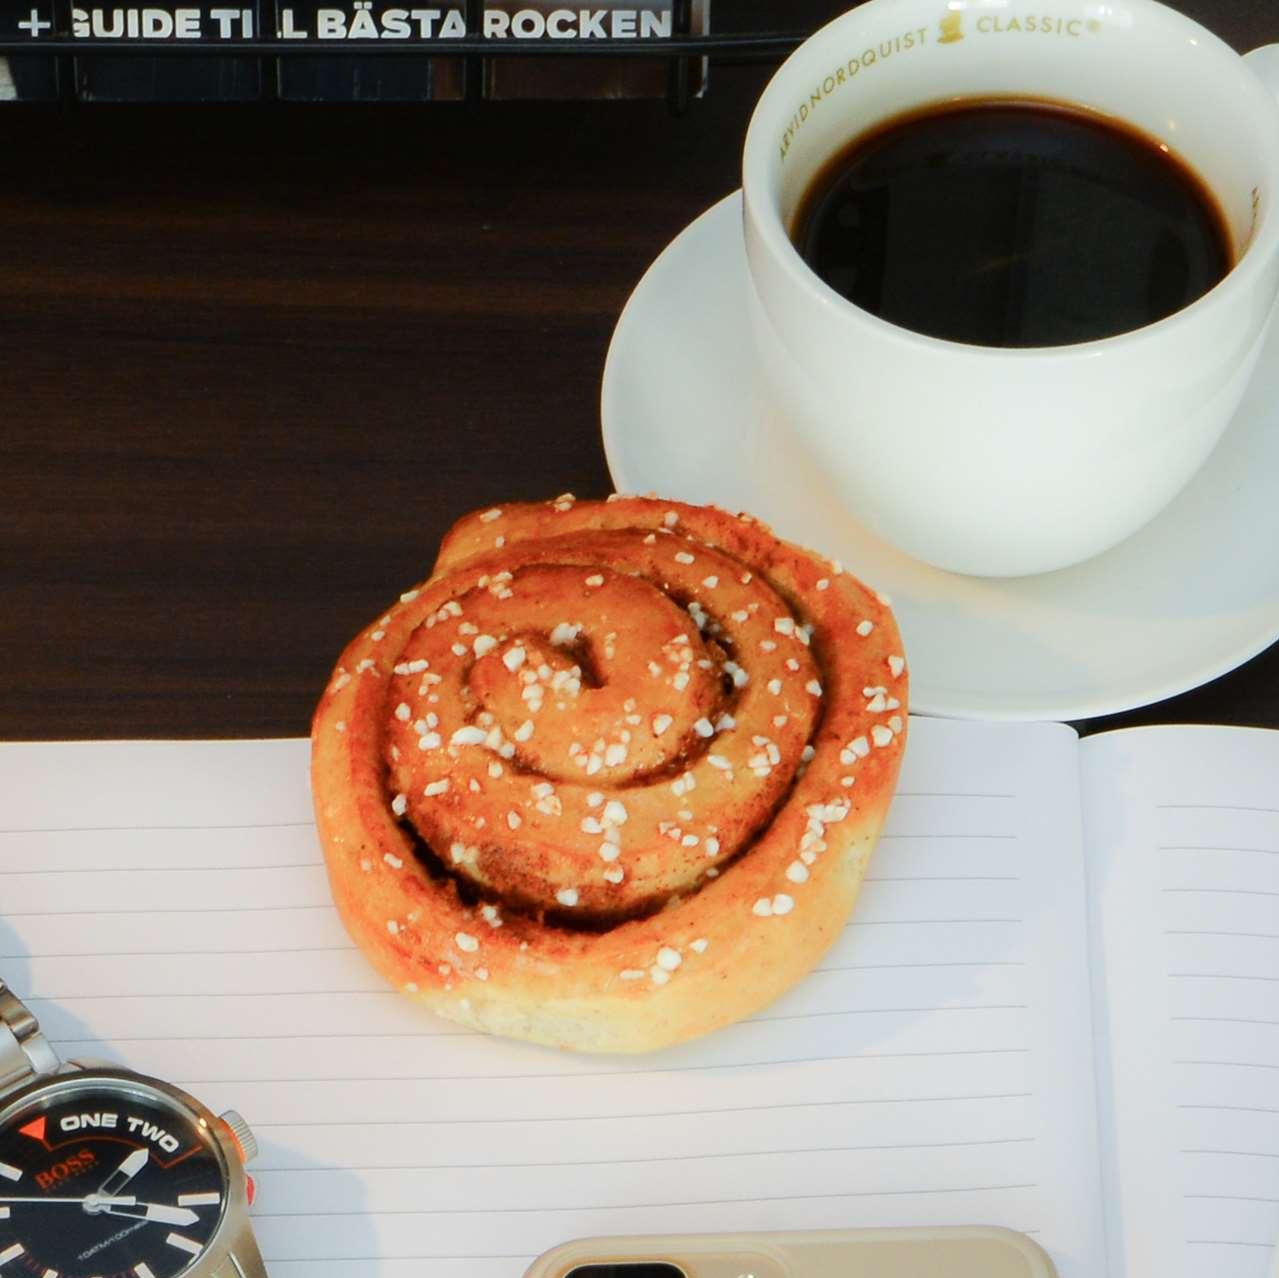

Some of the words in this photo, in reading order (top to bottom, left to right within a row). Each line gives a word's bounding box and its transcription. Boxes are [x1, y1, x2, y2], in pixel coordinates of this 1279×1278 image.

[210, 9, 307, 38] TIL
[317, 1, 466, 38] BÄSTA
[483, 9, 671, 38] ROCKEN
[59, 1112, 119, 1132] ONE
[126, 1114, 180, 1154] TWO
[35, 1149, 97, 1189] BOSS
